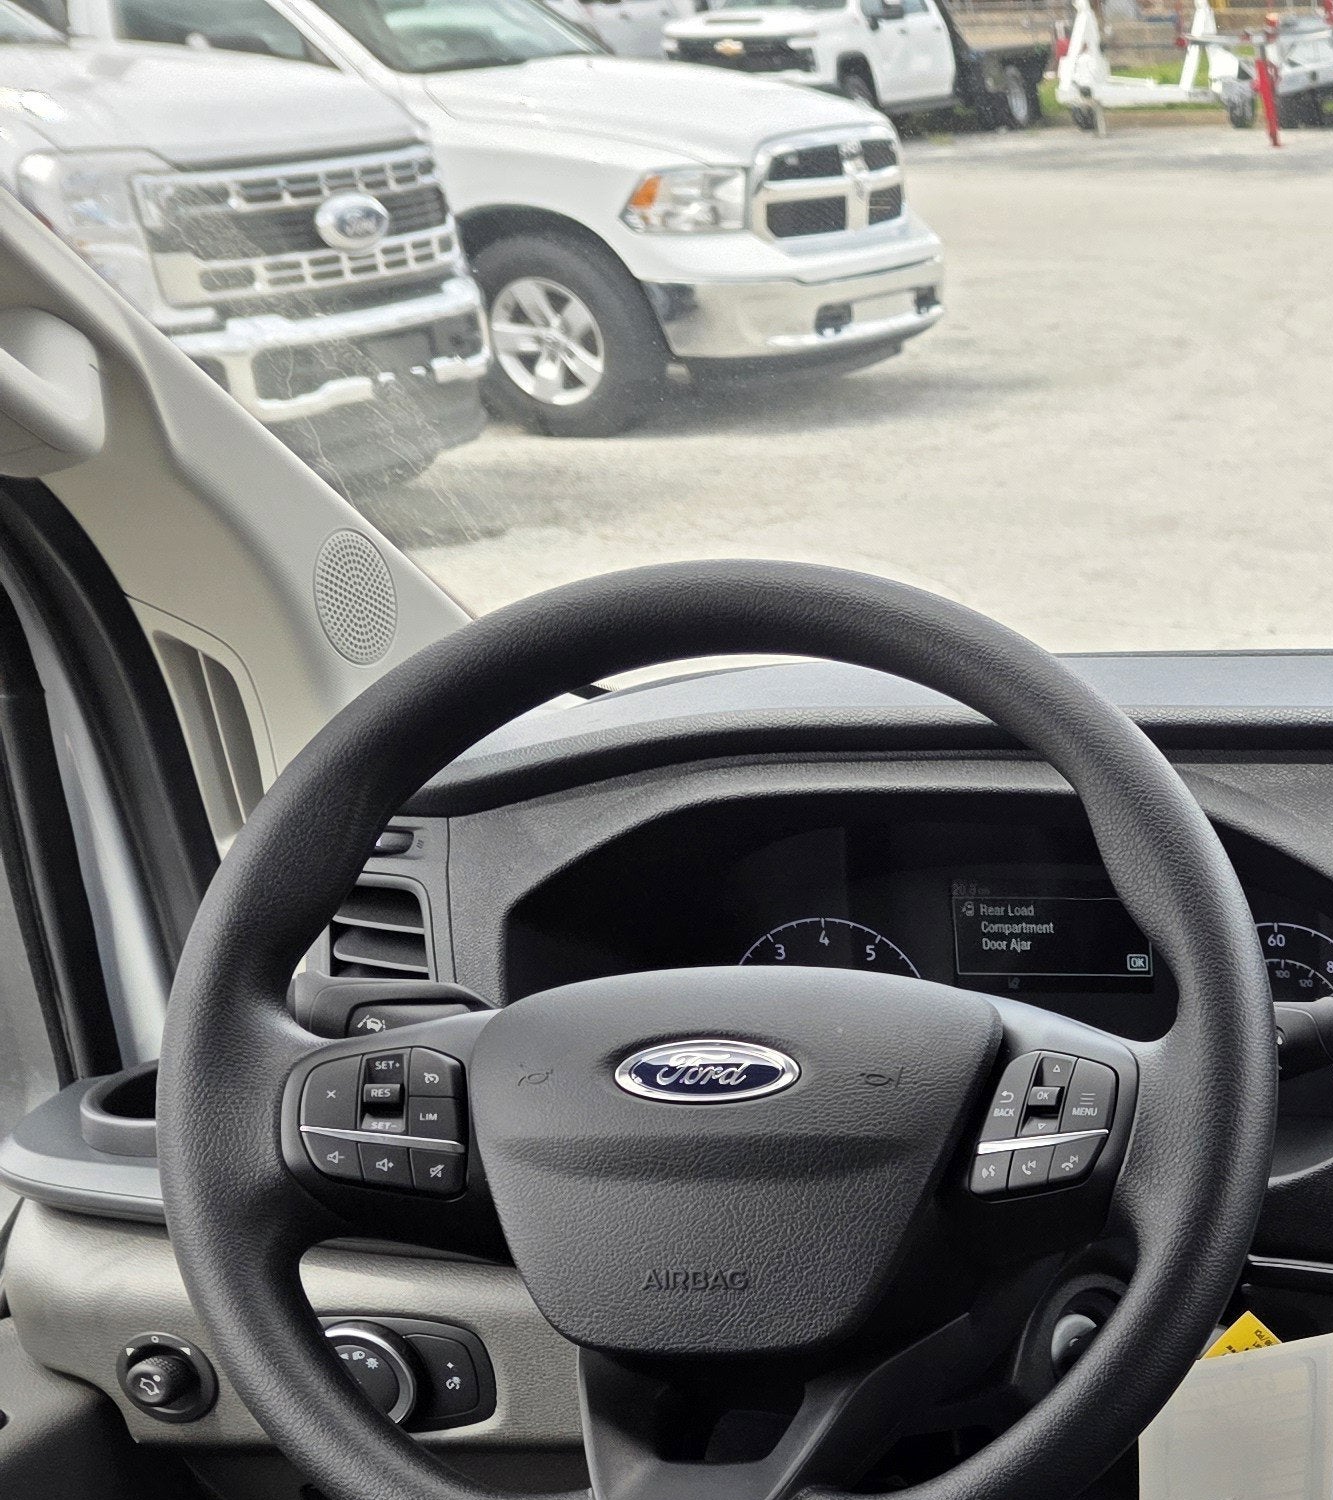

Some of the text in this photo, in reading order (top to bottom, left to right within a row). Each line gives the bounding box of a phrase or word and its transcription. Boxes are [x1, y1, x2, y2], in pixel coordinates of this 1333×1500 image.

[980, 903, 1035, 917] Rear Load
[981, 921, 1055, 936] Compartment
[819, 930, 830, 947] 4
[981, 937, 1032, 953] Door Ajar
[1267, 933, 1287, 948] 60
[774, 943, 787, 962] 3
[865, 940, 876, 960] 5
[1130, 957, 1145, 968] OK
[374, 1060, 400, 1071] SET+
[654, 1051, 749, 1087] Ford
[370, 1088, 391, 1098] RES
[1036, 1091, 1050, 1100] OK
[419, 1112, 438, 1121] LIM
[993, 1108, 1015, 1117] BACK
[1071, 1107, 1098, 1117] MENU
[642, 1269, 750, 1292] AIRBAG
